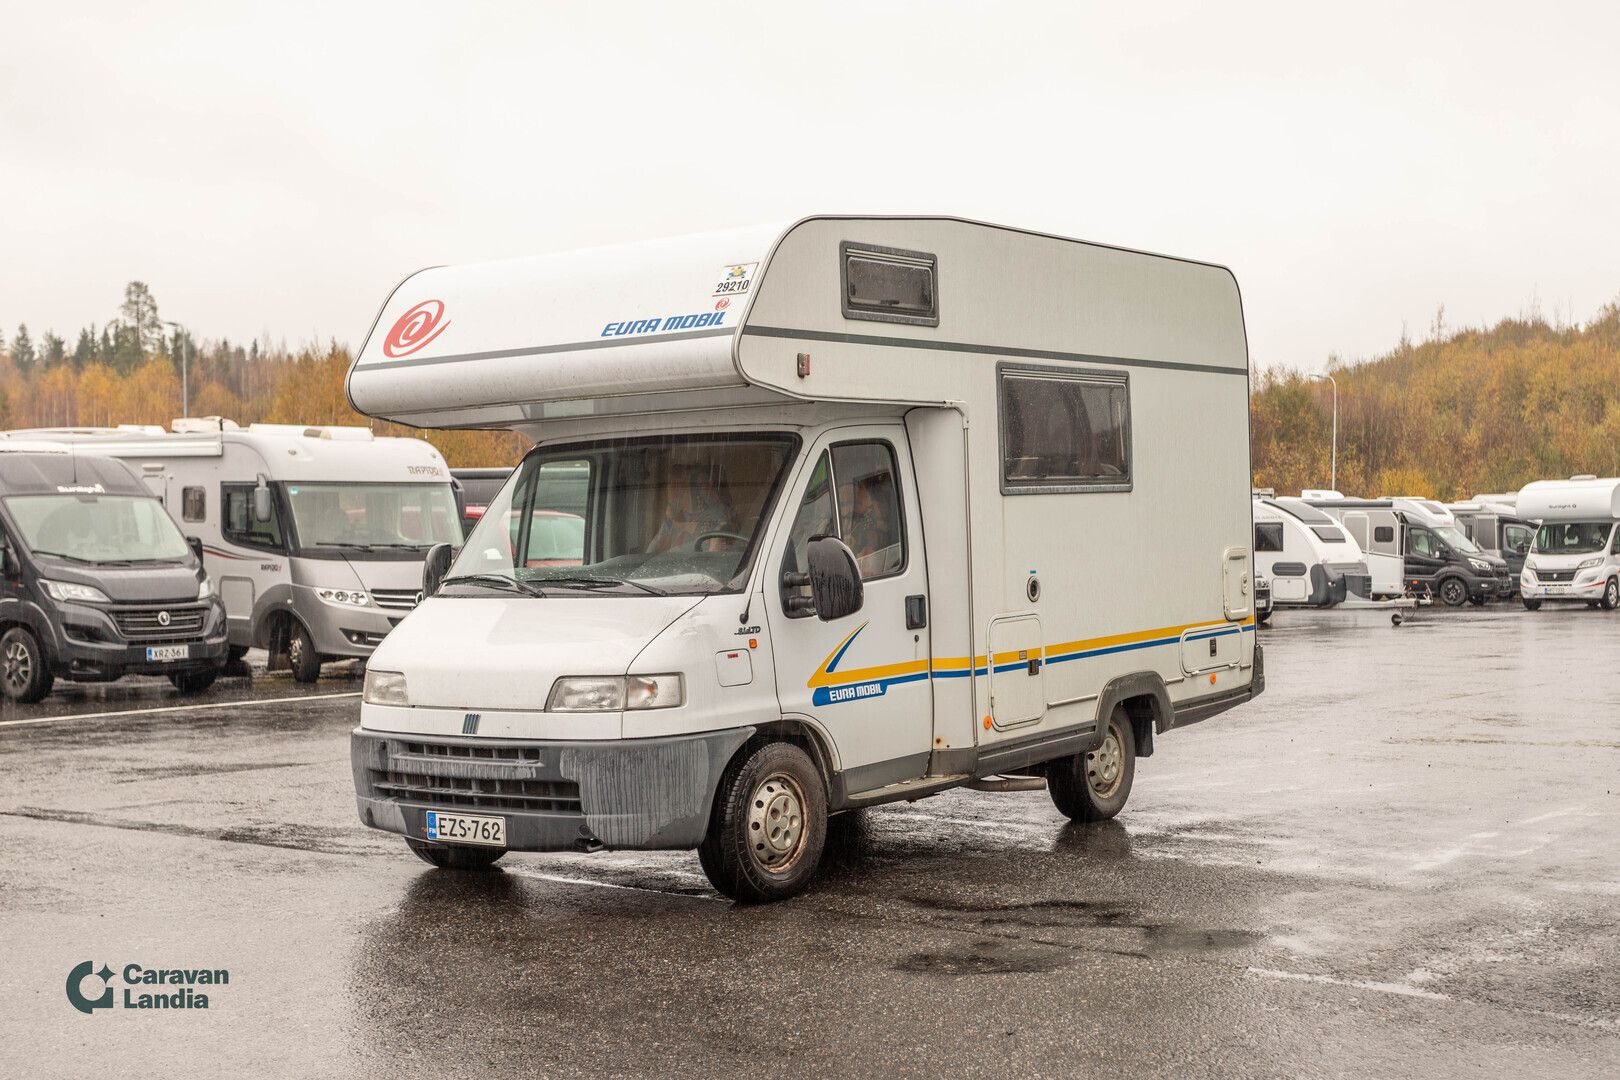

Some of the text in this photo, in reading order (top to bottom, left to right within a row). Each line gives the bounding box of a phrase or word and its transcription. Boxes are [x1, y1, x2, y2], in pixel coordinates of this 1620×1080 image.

[715, 279, 750, 293] 29210
[601, 311, 726, 337] EURA MOBIL
[153, 648, 186, 659] XRZ-361
[829, 683, 883, 702] EURA MOBIL
[438, 817, 501, 841] EZS-762
